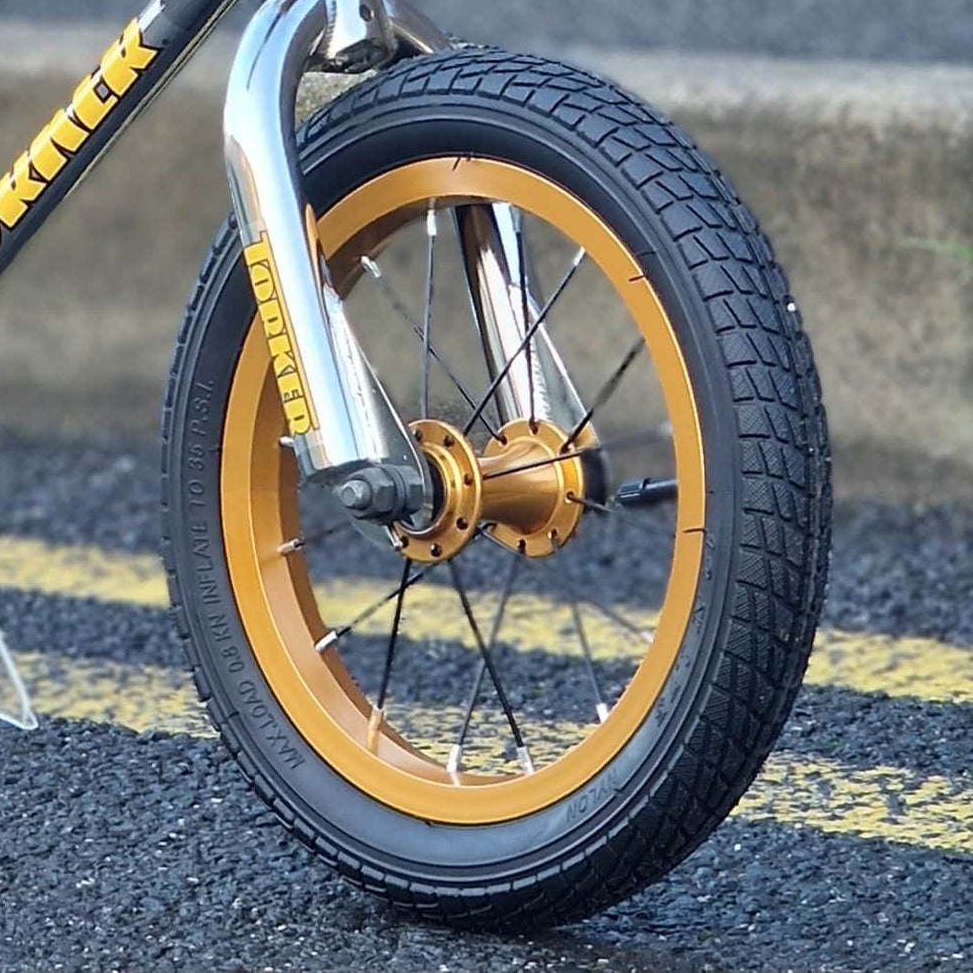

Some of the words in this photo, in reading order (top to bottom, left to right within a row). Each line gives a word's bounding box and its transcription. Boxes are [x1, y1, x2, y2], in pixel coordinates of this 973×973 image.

[244, 230, 319, 435] TORKER
[188, 481, 207, 508] TO
[191, 519, 222, 605] INFLATE
[210, 613, 233, 642] KN
